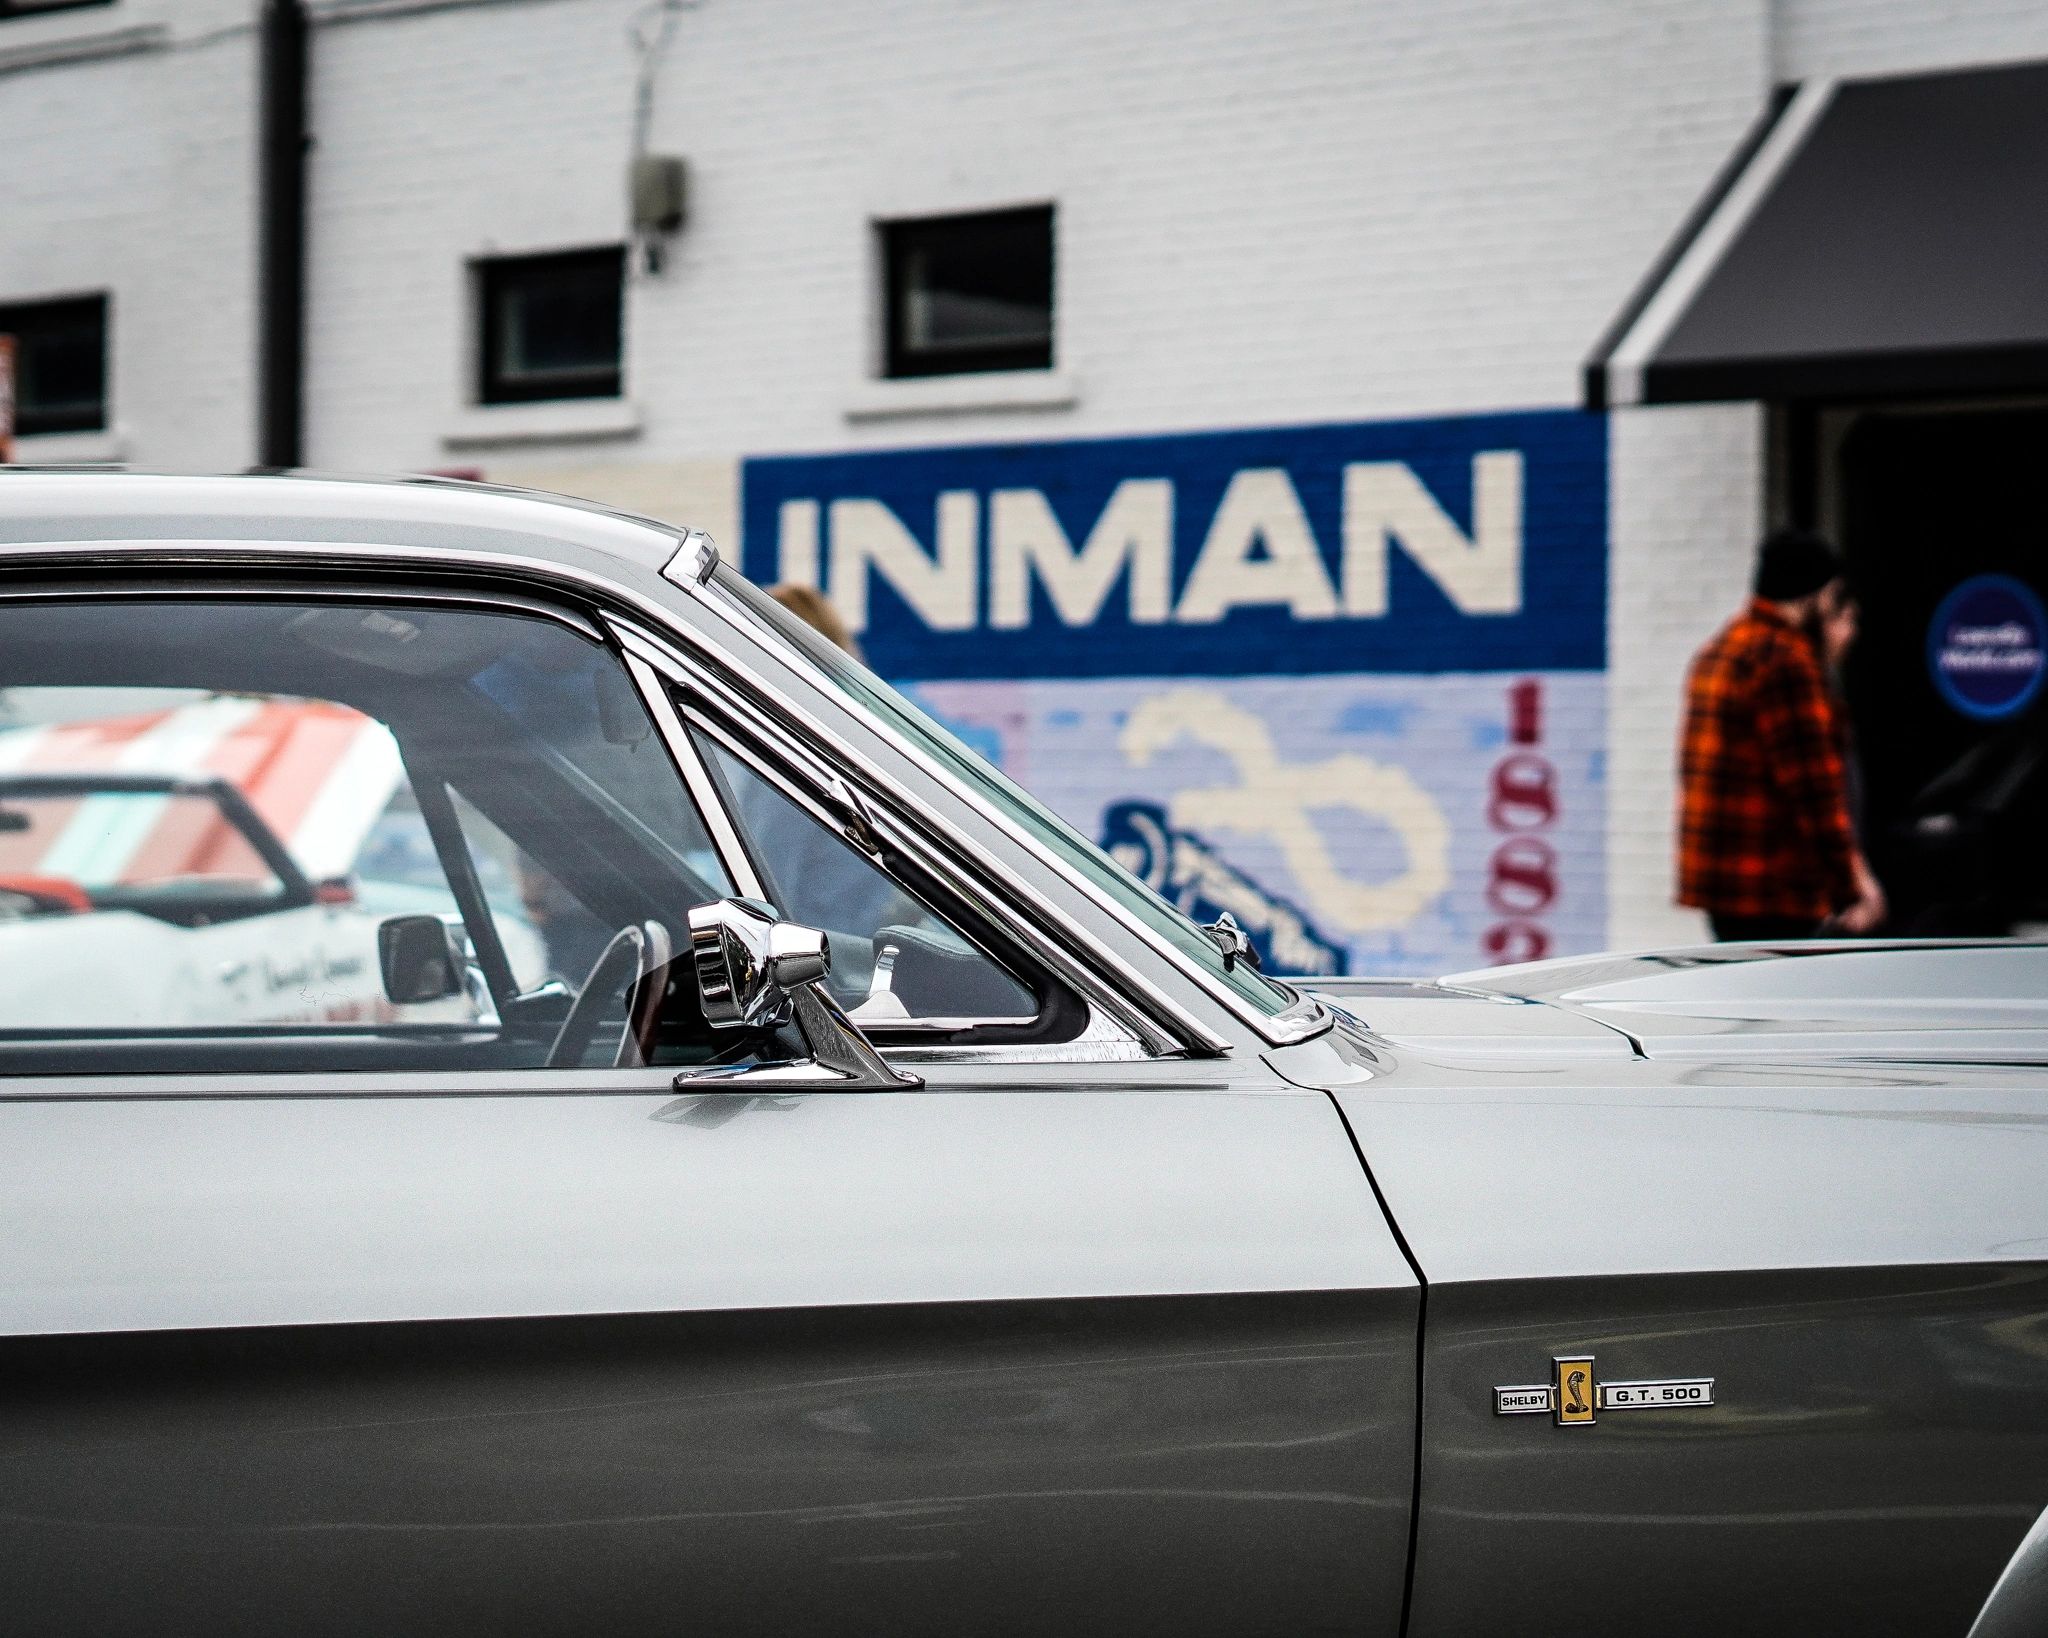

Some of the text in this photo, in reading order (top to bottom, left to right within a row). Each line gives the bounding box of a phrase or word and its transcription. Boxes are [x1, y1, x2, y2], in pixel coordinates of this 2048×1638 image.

[779, 452, 1524, 632] INMAN
[1502, 1396, 1545, 1406] SHELBY
[1662, 1388, 1701, 1400] 500
